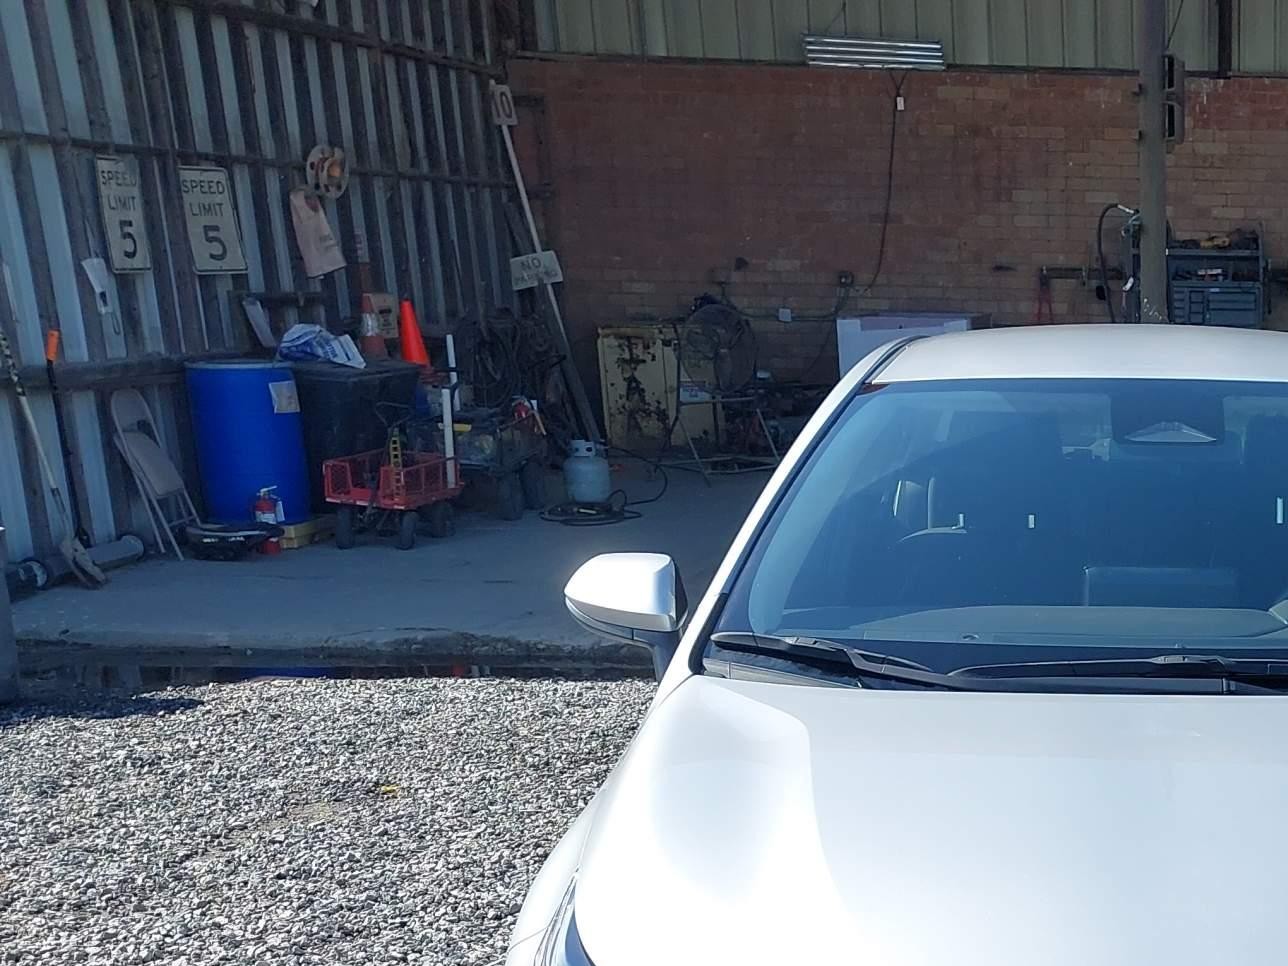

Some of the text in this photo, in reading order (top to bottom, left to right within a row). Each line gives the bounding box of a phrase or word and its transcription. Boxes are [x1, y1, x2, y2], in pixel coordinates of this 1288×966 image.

[101, 170, 137, 187] SPEED
[181, 179, 226, 195] SPEED
[108, 196, 136, 211] LIMIT
[190, 203, 224, 217] LIMIT
[119, 220, 138, 259] 5
[203, 225, 228, 261] 5
[520, 257, 542, 270] NO
